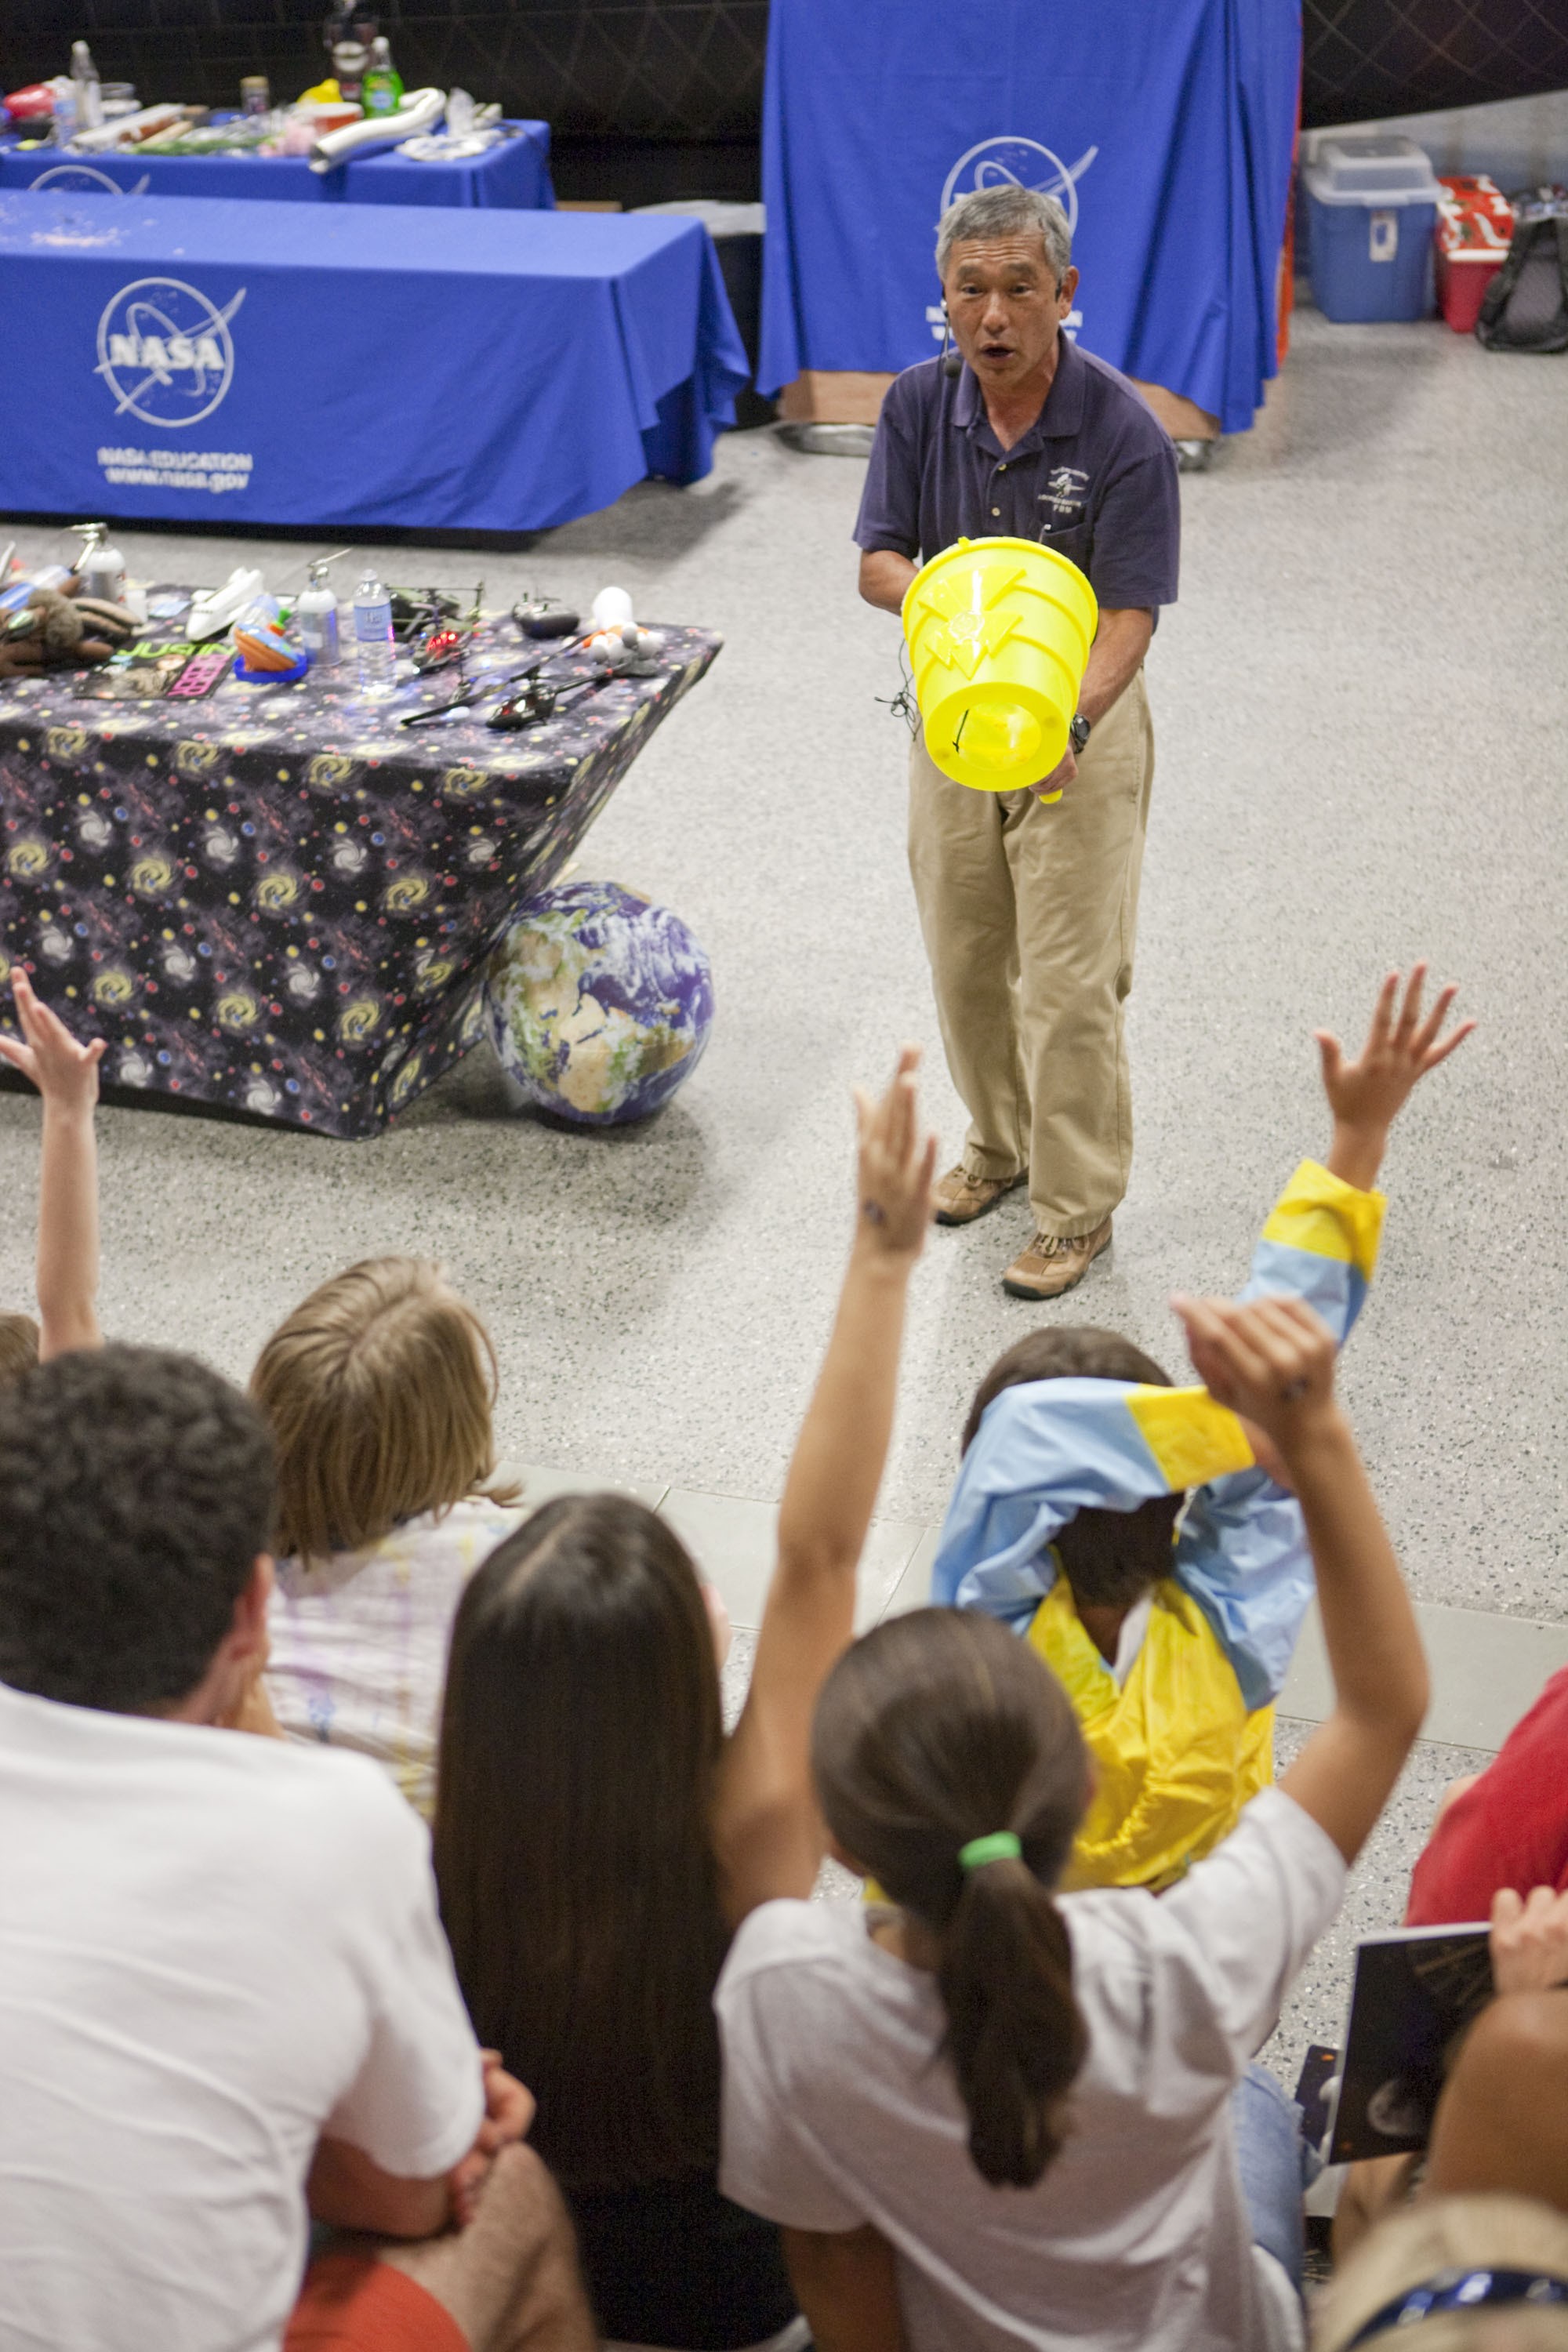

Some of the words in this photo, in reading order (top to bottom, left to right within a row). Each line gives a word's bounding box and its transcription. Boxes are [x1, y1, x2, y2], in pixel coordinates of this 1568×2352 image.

[108, 333, 226, 371] NASA
[96, 447, 145, 466] NASA
[147, 450, 253, 472] EDUCATION
[104, 468, 250, 494] www.nasa.gov
[118, 641, 238, 658] JUSTIN
